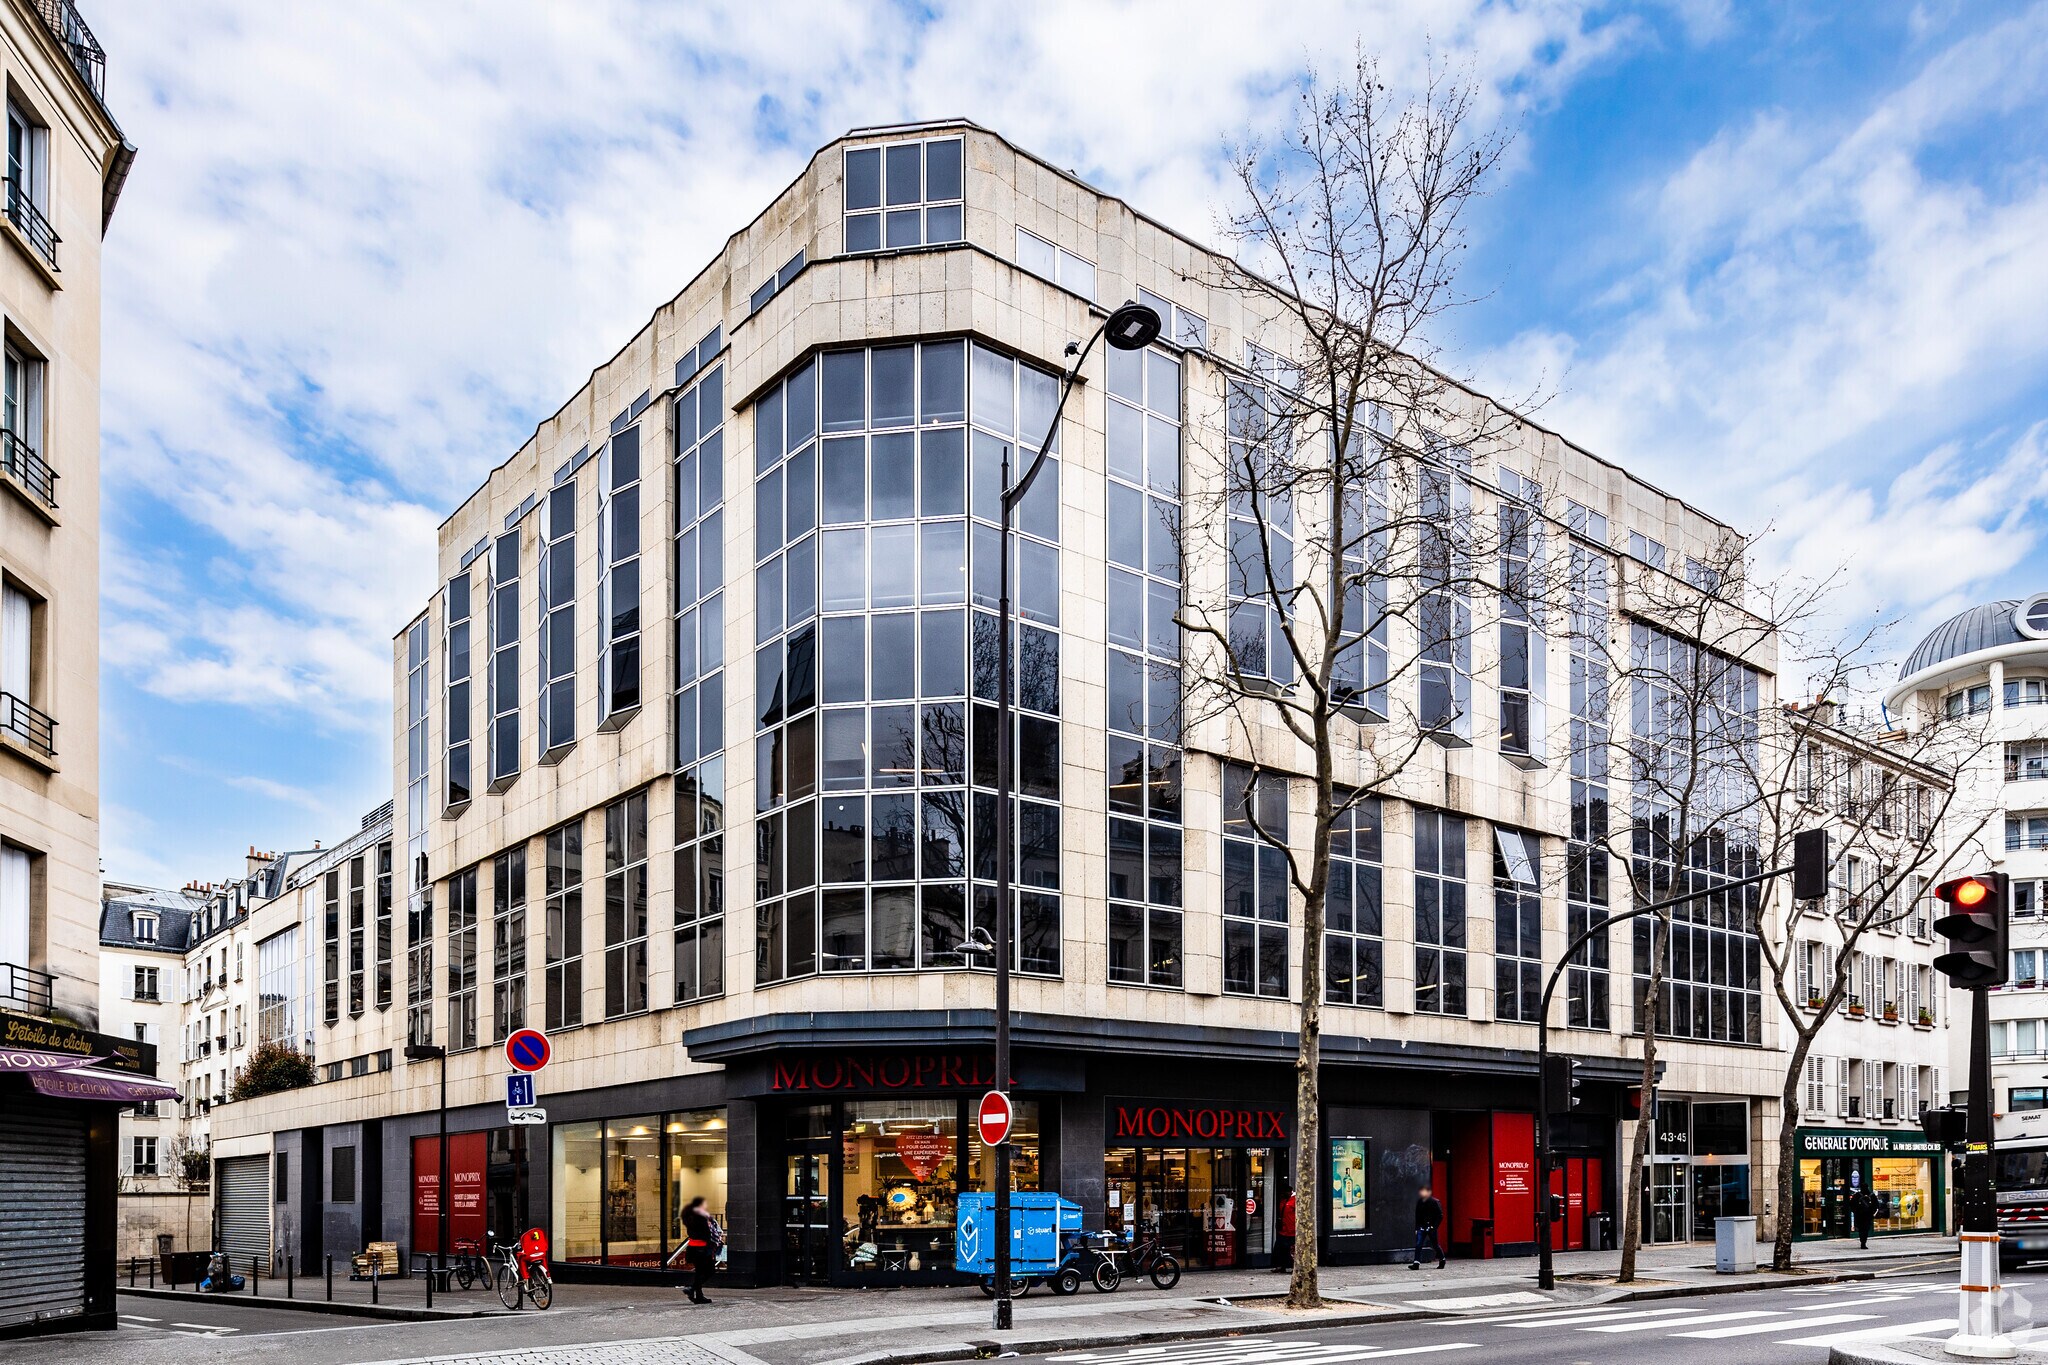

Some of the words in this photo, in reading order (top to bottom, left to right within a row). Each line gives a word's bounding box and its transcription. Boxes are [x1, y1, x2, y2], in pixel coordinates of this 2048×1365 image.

[48, 1030, 62, 1047] de
[63, 1032, 93, 1055] clichy
[67, 1082, 79, 1093] DE
[80, 1083, 111, 1095] CLICHY
[1116, 1107, 1286, 1138] MONOPRIX
[1849, 1137, 1889, 1150] D'OPTIQUE
[418, 1174, 439, 1183] MONOPRIX
[454, 1172, 480, 1183] MONOPRIX
